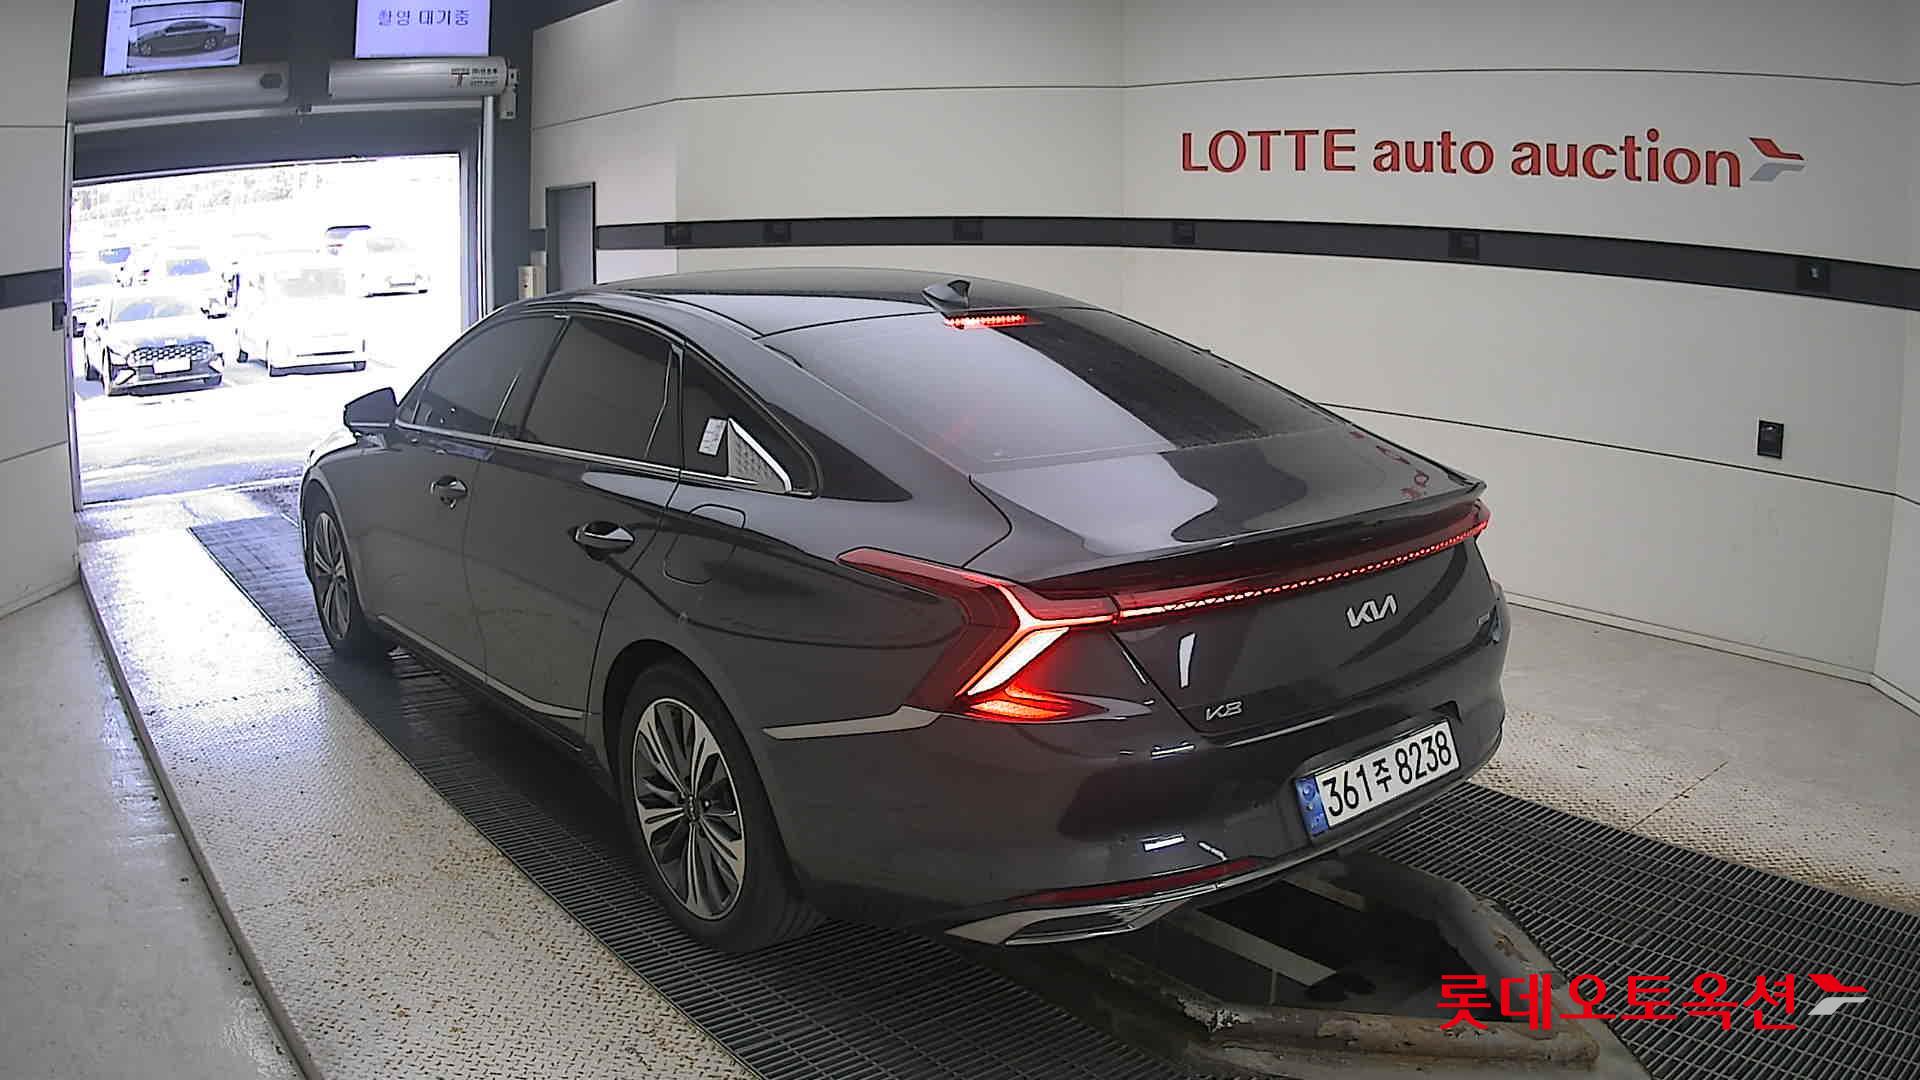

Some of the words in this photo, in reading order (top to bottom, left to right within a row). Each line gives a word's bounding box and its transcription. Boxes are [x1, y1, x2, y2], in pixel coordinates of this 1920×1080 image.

[419, 9, 470, 26] 대기중
[1181, 128, 1357, 173] LOTTE
[1372, 130, 1495, 175] auto
[1510, 127, 1742, 188] auction
[1346, 593, 1398, 628] KIA
[1205, 700, 1243, 721] K8
[1394, 730, 1452, 785] 8238
